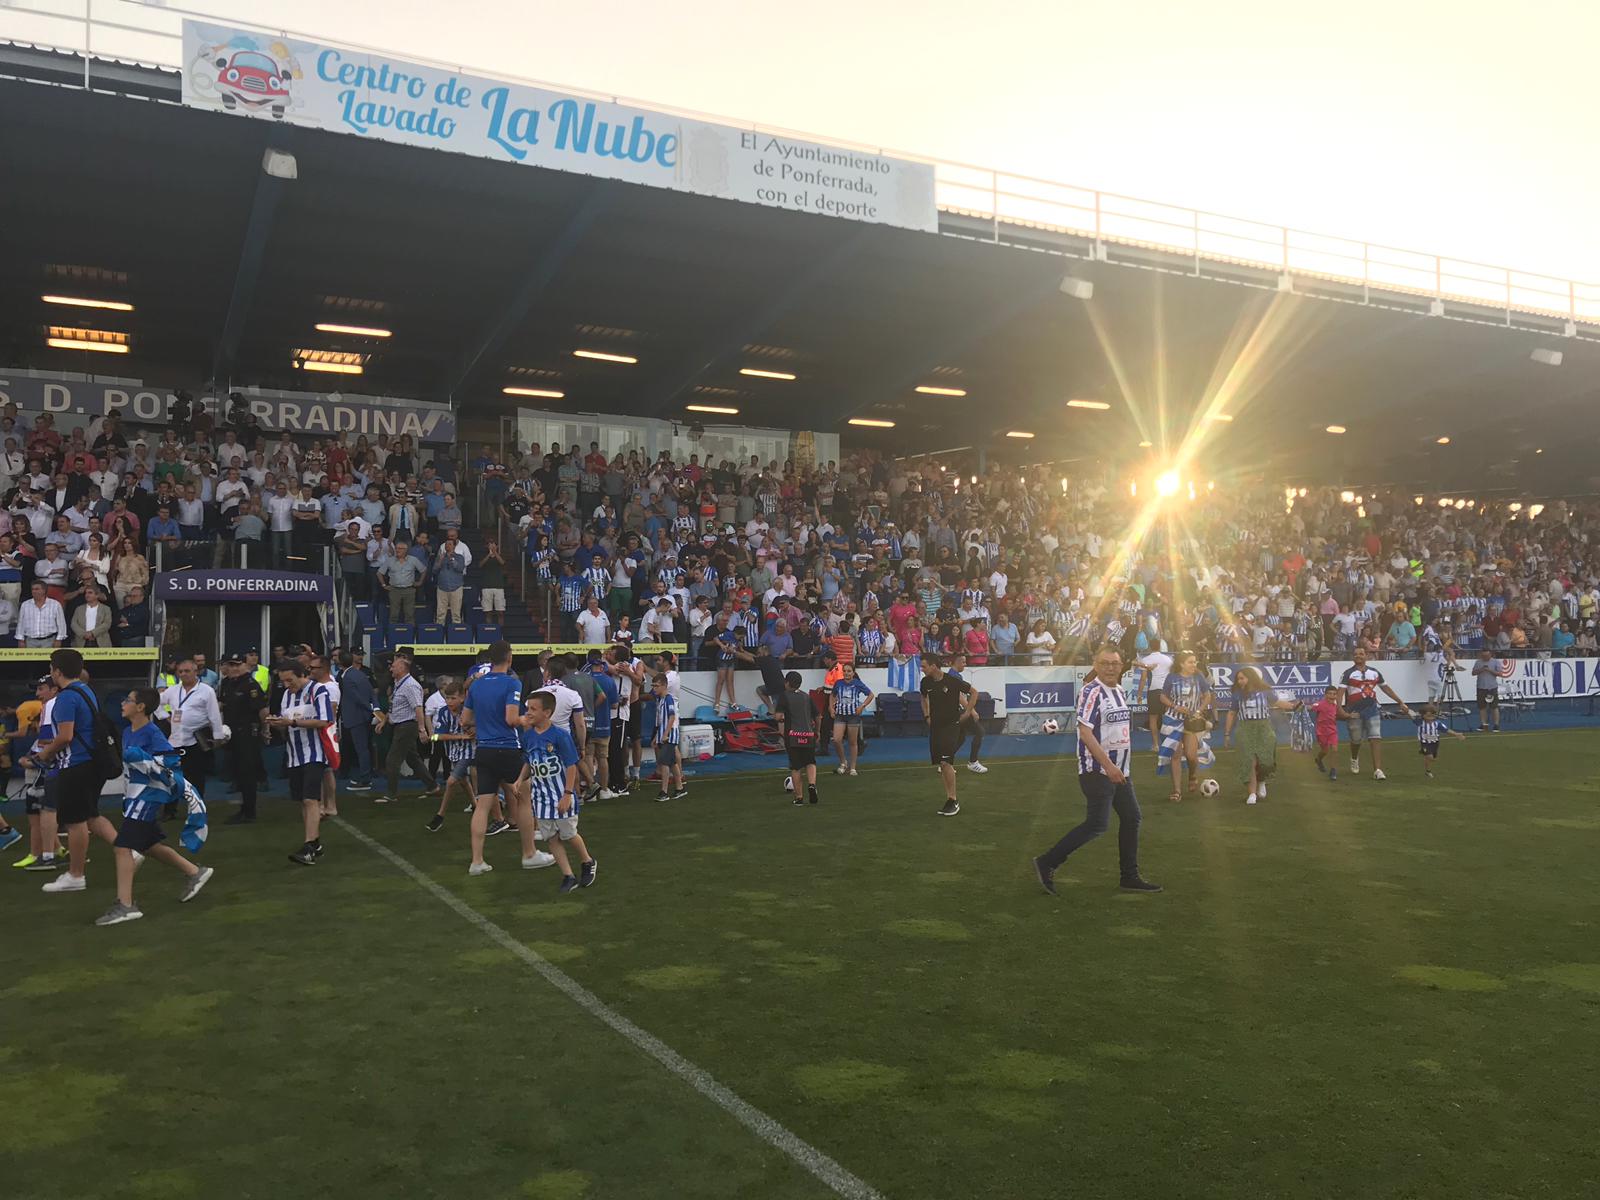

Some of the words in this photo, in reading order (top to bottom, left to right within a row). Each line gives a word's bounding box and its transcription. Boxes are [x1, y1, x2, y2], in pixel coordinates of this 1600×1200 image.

[316, 49, 427, 99] Centro
[435, 76, 472, 108] de
[337, 90, 457, 139] Lavado
[480, 85, 540, 160] La
[547, 98, 678, 168] Nube
[741, 132, 757, 151] El
[764, 137, 891, 175] Ayuntamiento
[753, 159, 775, 177] de
[781, 164, 879, 197] Ponferrada,
[756, 186, 787, 204] con
[794, 191, 808, 208] el
[815, 196, 877, 218] deporte
[43, 383, 85, 414] D.
[169, 578, 183, 590] S.
[187, 578, 202, 591] D.
[207, 578, 319, 592] PONFERRADINA
[1209, 665, 1329, 687] RVAL
[1523, 660, 1551, 678] AUTO
[1020, 689, 1060, 705] San
